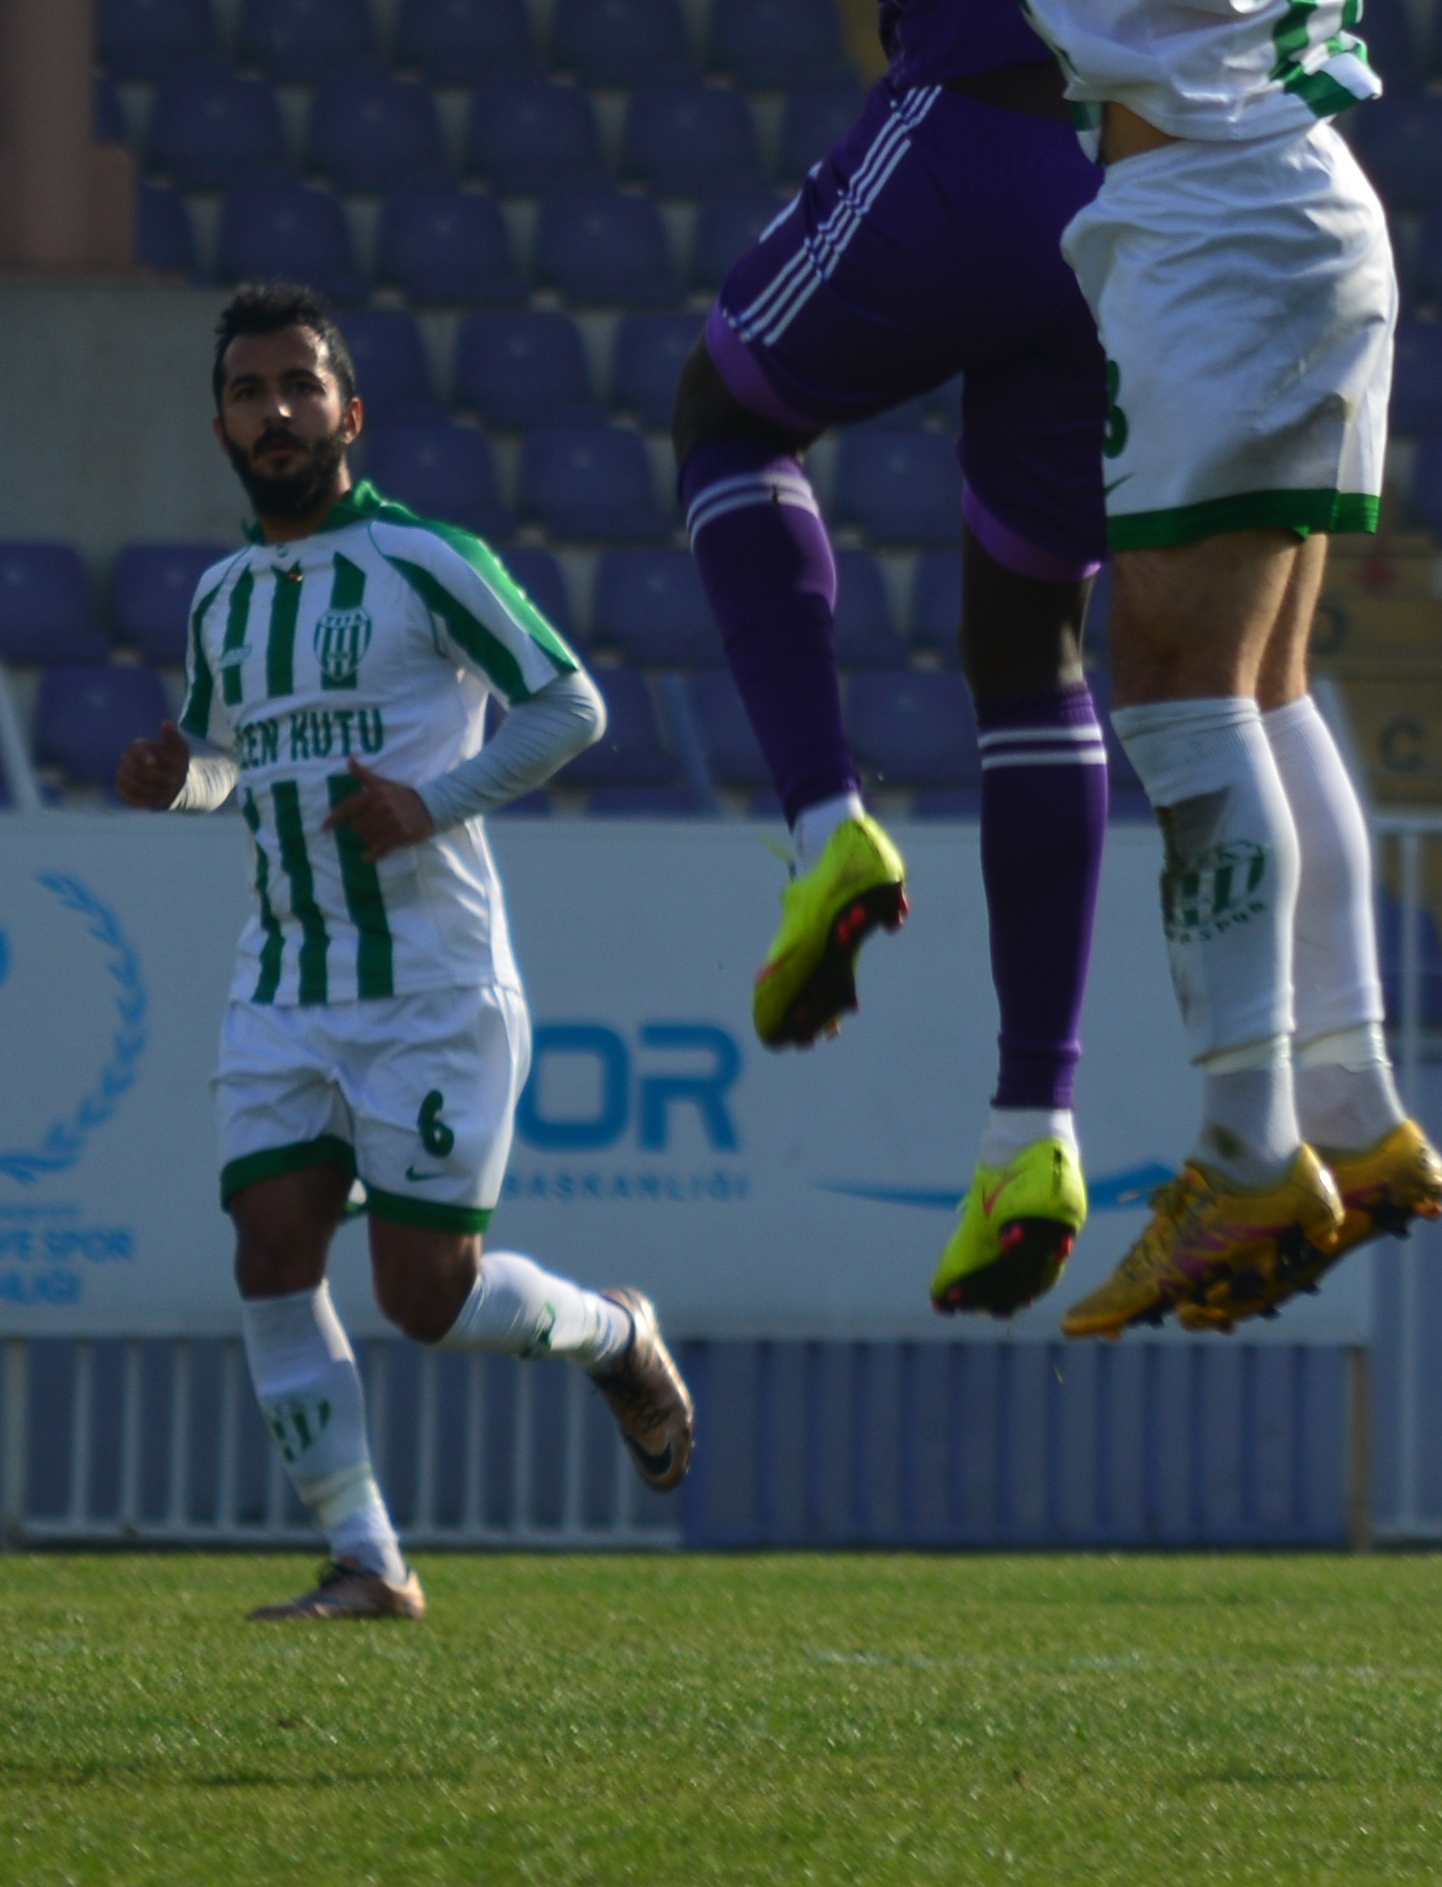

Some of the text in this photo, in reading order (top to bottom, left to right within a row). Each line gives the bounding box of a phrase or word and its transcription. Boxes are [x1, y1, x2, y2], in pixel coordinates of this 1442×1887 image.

[289, 706, 385, 761] KUTU
[1380, 715, 1425, 773] C
[417, 1090, 454, 1160] 6
